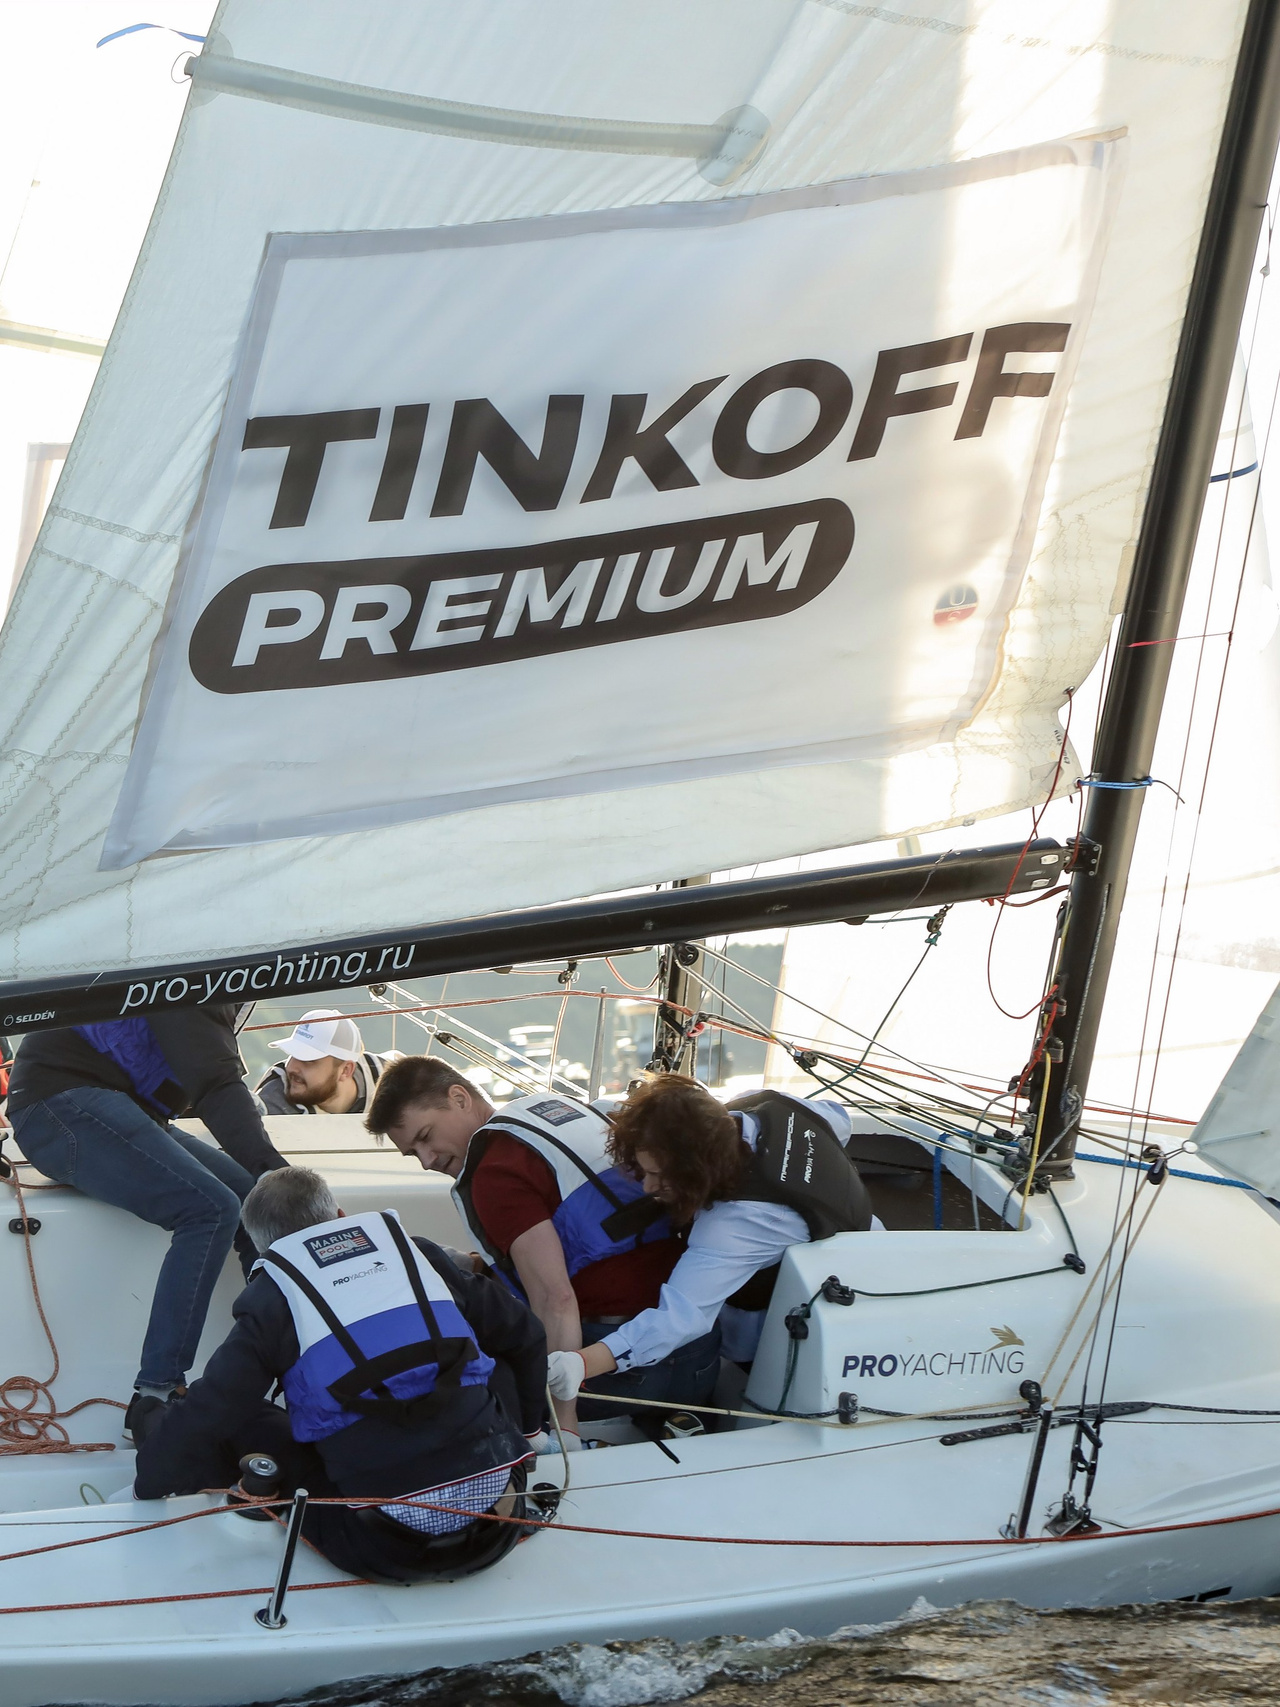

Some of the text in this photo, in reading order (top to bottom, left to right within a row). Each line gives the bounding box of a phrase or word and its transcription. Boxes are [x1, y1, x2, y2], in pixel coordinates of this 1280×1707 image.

[241, 321, 1072, 530] TINKOFF
[231, 520, 821, 668] PREMIUM
[119, 943, 417, 1015] pro-yachting.ru
[14, 1009, 56, 1024] SELDÉN
[310, 1229, 362, 1251] MARINE
[320, 1243, 348, 1257] POOL
[332, 1265, 388, 1287] PROYACHTING
[841, 1351, 1025, 1378] PROYACHTING
